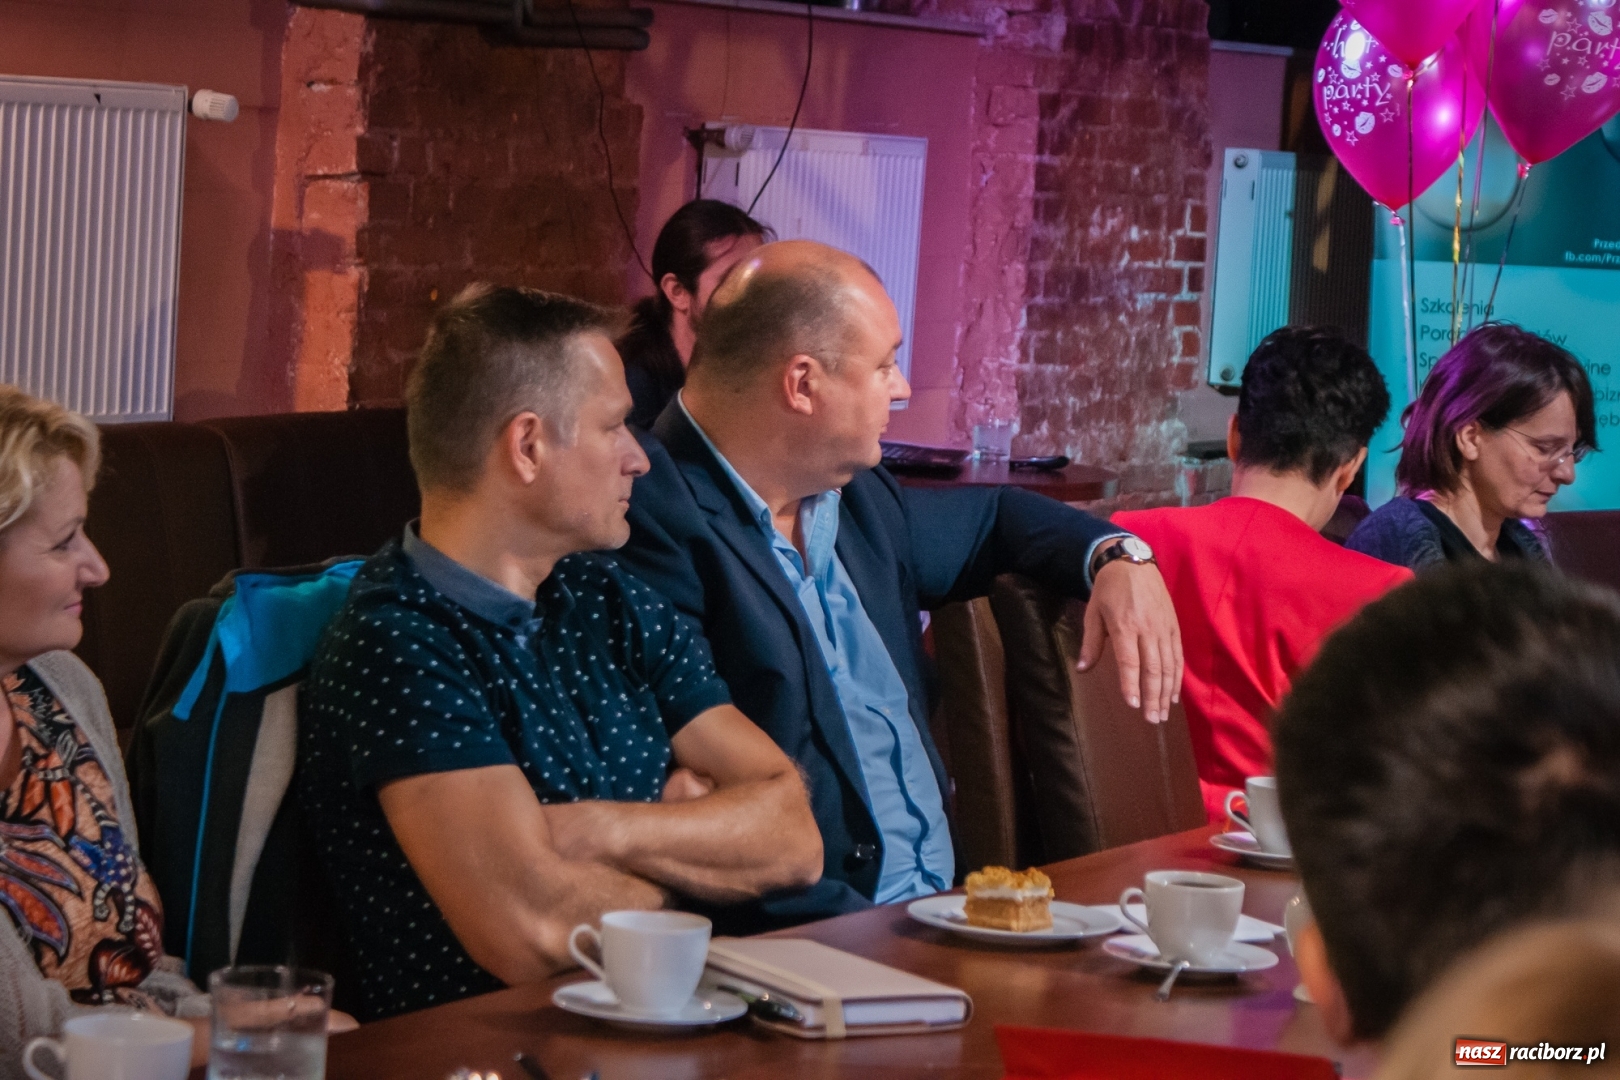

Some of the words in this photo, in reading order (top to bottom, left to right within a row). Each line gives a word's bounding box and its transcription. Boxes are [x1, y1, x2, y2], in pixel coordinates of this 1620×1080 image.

[1546, 31, 1620, 70] part
[1323, 76, 1391, 111] party
[1420, 297, 1494, 316] Szkolenia
